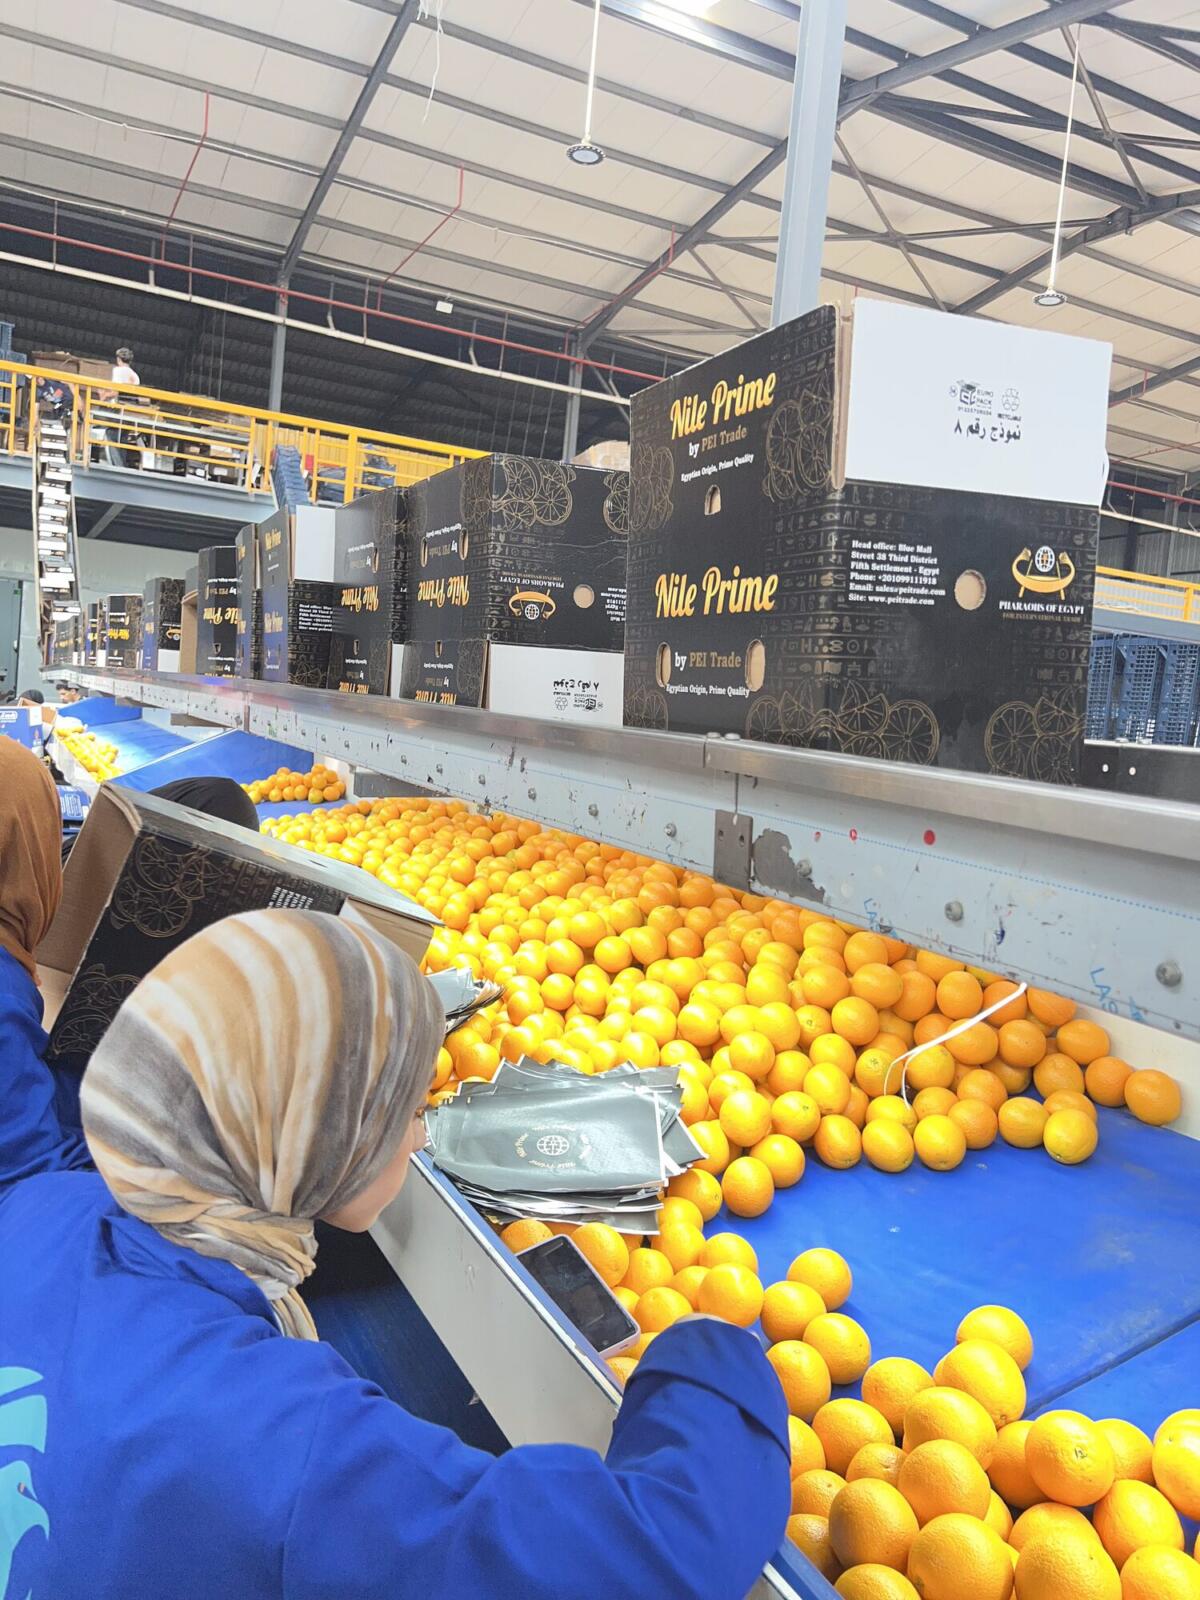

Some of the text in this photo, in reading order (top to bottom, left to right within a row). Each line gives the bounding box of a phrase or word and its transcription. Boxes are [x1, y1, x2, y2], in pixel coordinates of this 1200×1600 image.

[670, 372, 776, 440] Nile Prime
[966, 417, 986, 440] رقم
[990, 422, 1021, 443] نموذج
[688, 425, 748, 458] by PEI Trade
[718, 459, 734, 471] Prime
[734, 453, 754, 468] Quality
[852, 540, 932, 554] Head office: Blue Mall
[851, 551, 874, 560] Street
[888, 554, 908, 562] Third
[910, 556, 938, 564] District
[850, 561, 870, 570] Fifth
[871, 563, 912, 573] Settlement
[918, 566, 940, 576] Egypt
[850, 572, 876, 580] Phone:
[417, 574, 470, 608] Nile Prime
[655, 565, 779, 618] Nile Prime
[849, 582, 874, 591] Email:
[848, 593, 934, 605] Site: www.peitrade.com
[999, 600, 1084, 614] PHARAOHS OF EGYPT
[674, 652, 741, 671] by PEI Trade
[666, 683, 750, 698] Egyptian Origin, Prime Quality
